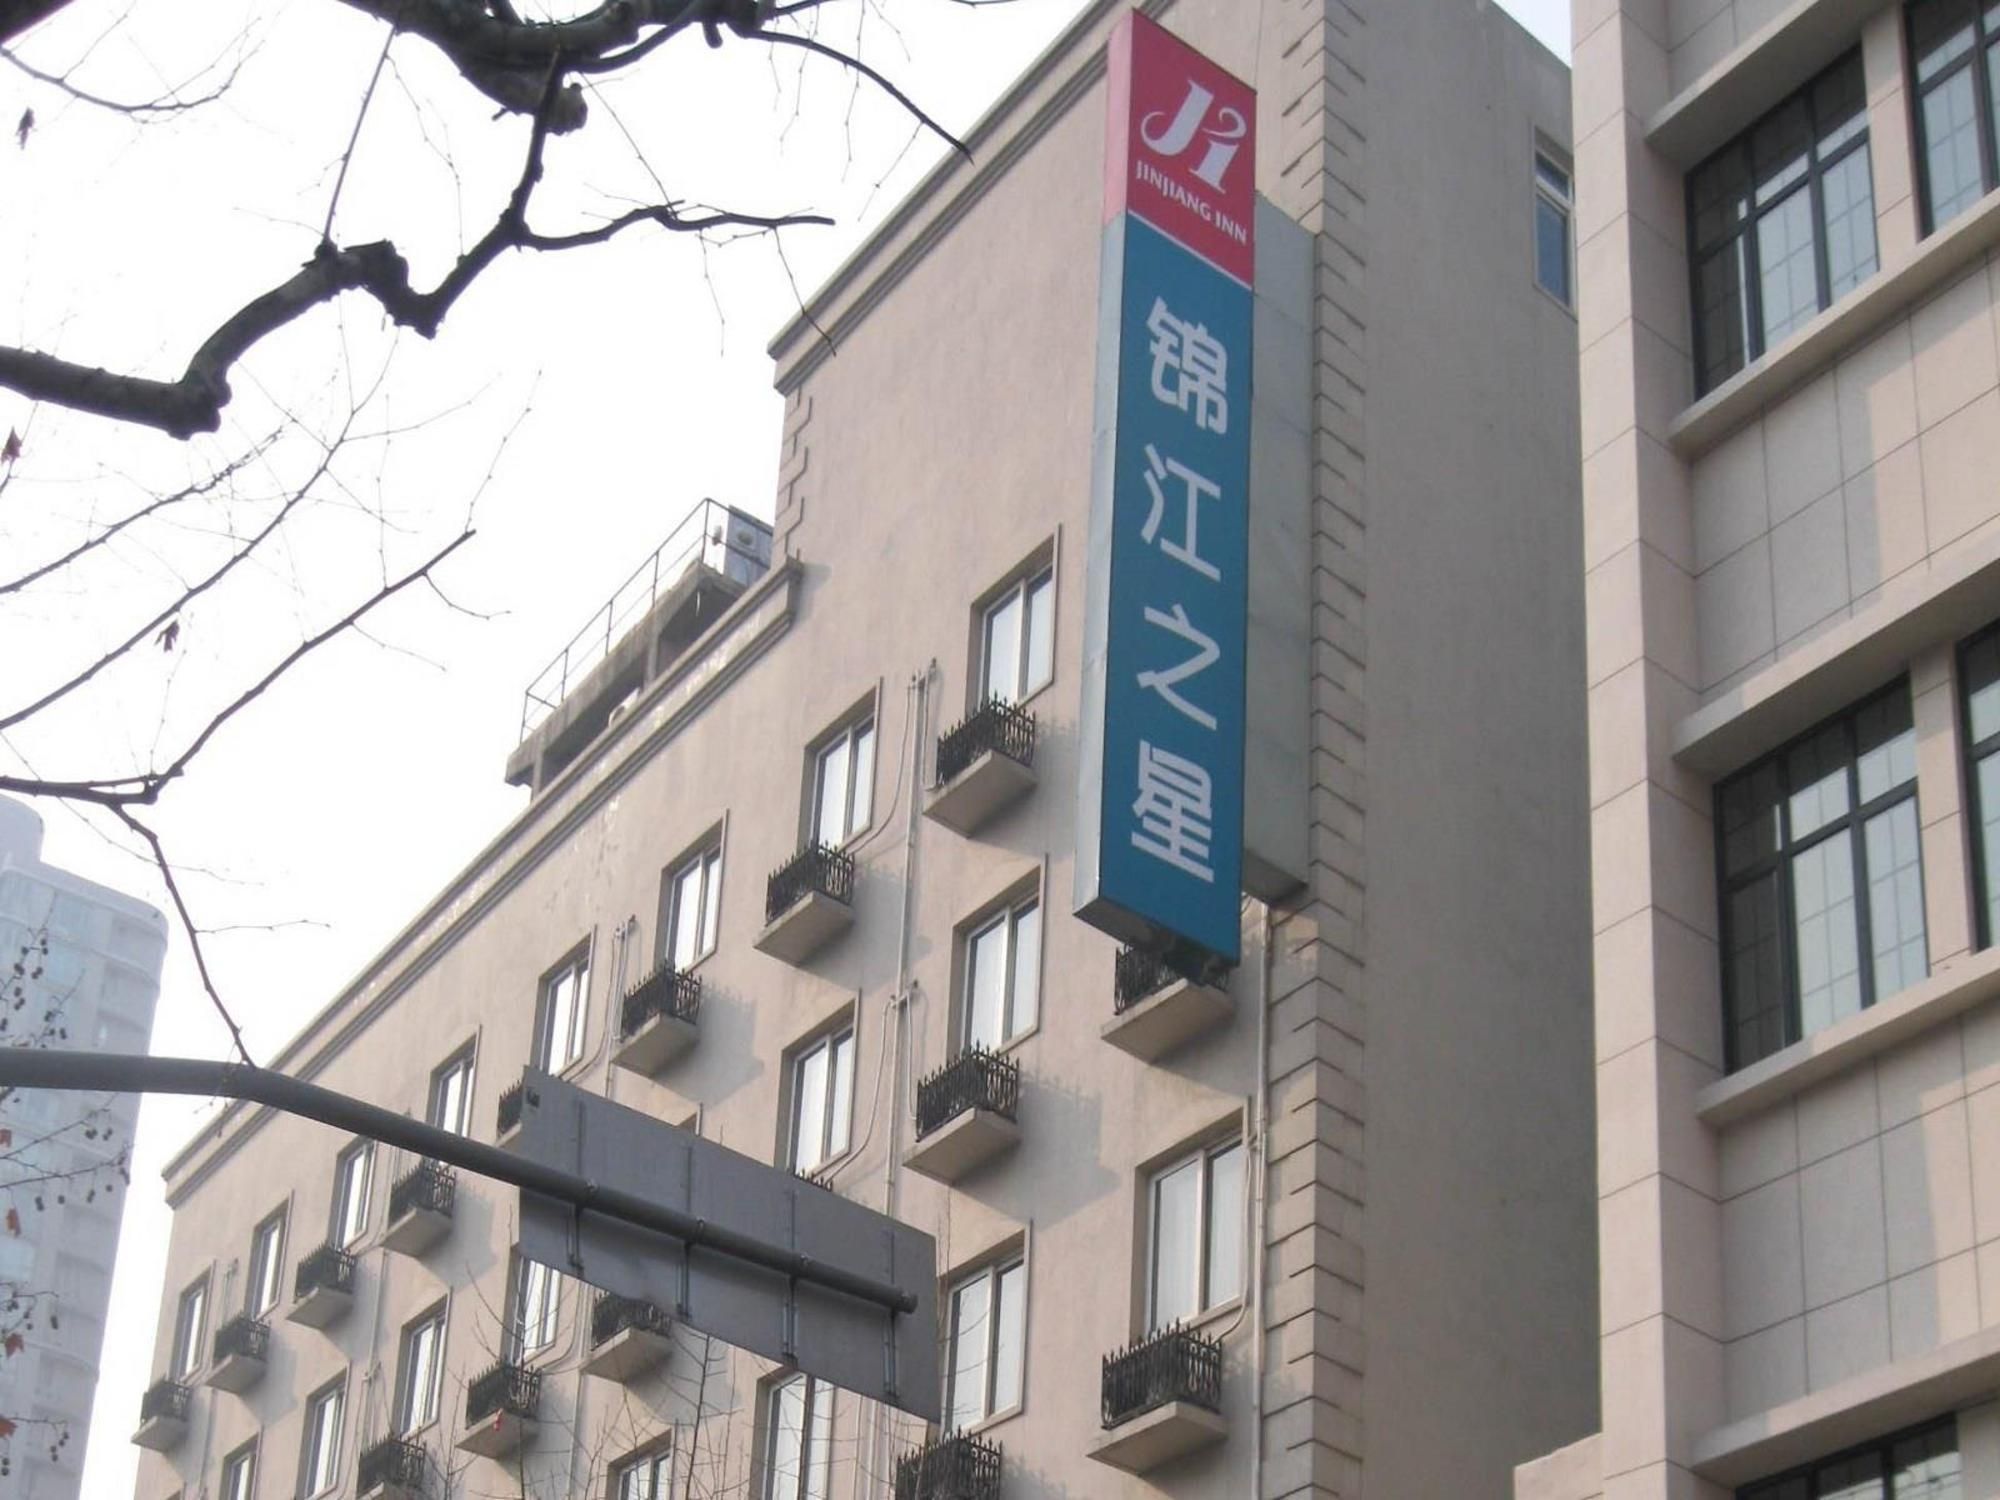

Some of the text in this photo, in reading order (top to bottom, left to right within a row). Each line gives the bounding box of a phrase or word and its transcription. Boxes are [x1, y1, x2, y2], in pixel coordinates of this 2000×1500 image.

[1136, 160, 1248, 246] JINJIANG INN
[1131, 296, 1228, 884] 锦江之星
